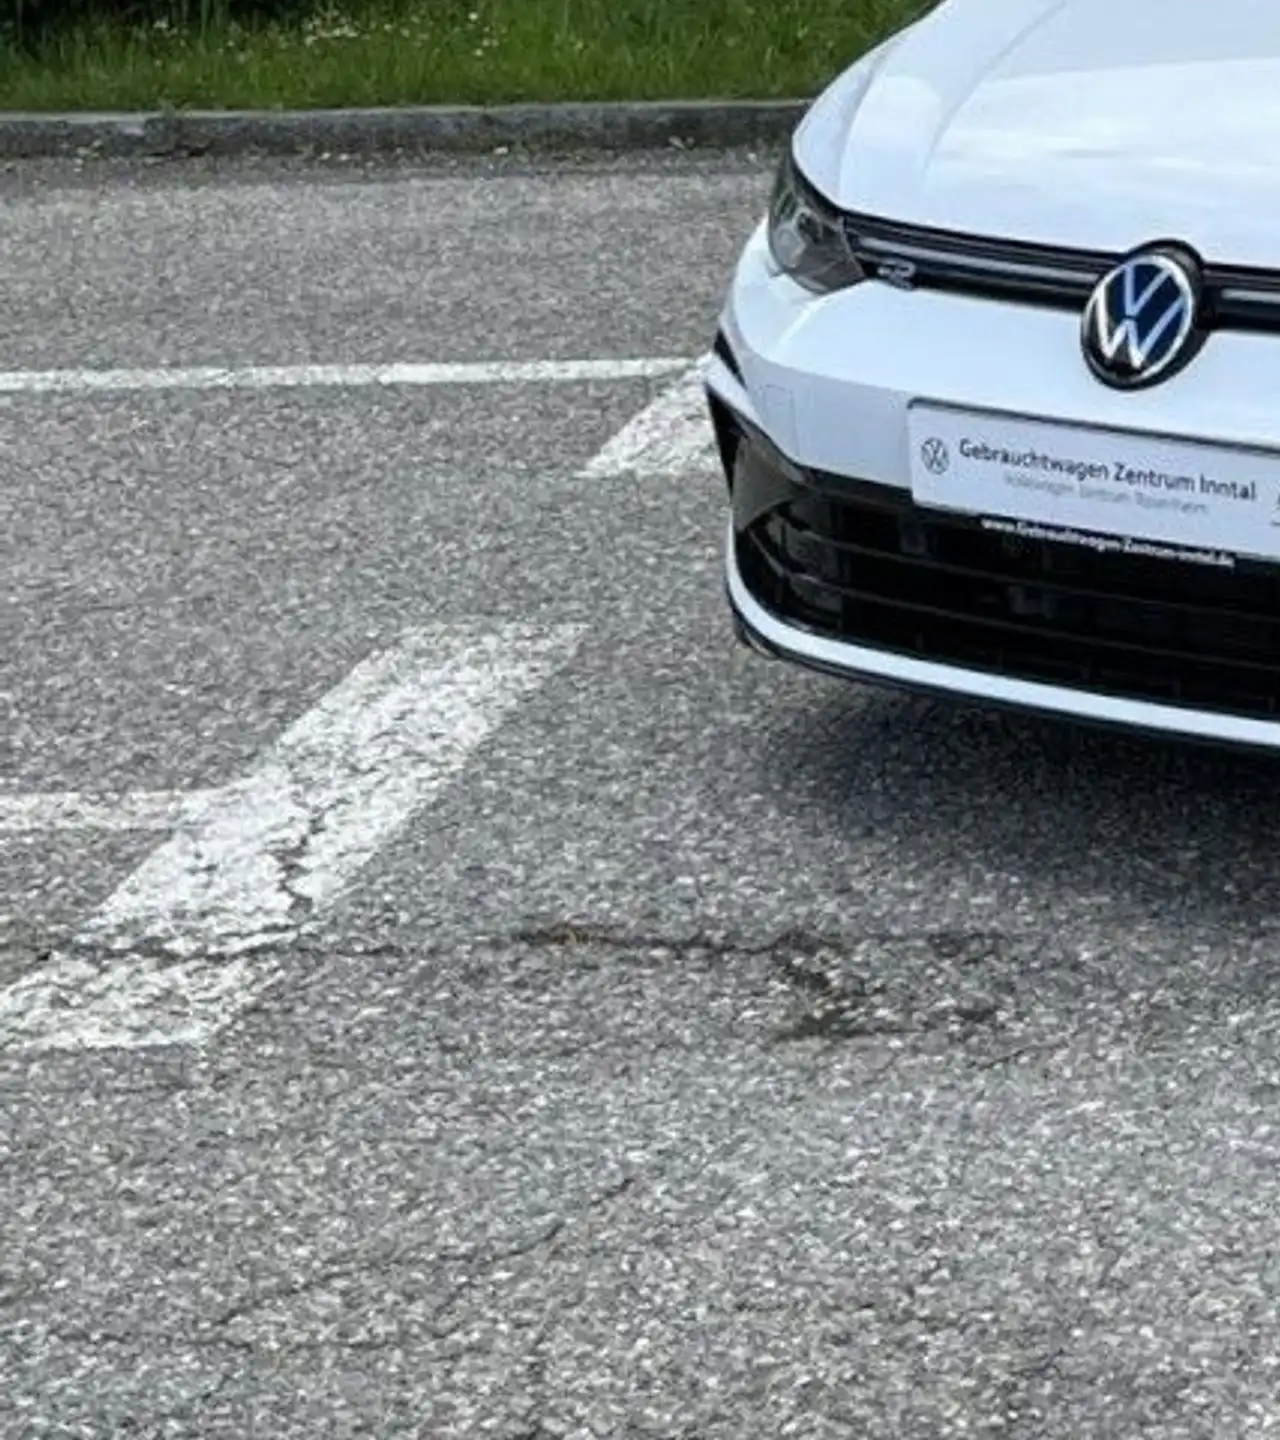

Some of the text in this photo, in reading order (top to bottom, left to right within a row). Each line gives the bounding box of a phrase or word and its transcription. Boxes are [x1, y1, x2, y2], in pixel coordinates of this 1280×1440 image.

[1090, 255, 1194, 379] VW
[958, 437, 1258, 501] Gebrauchtwagen Zentrum Inntal
